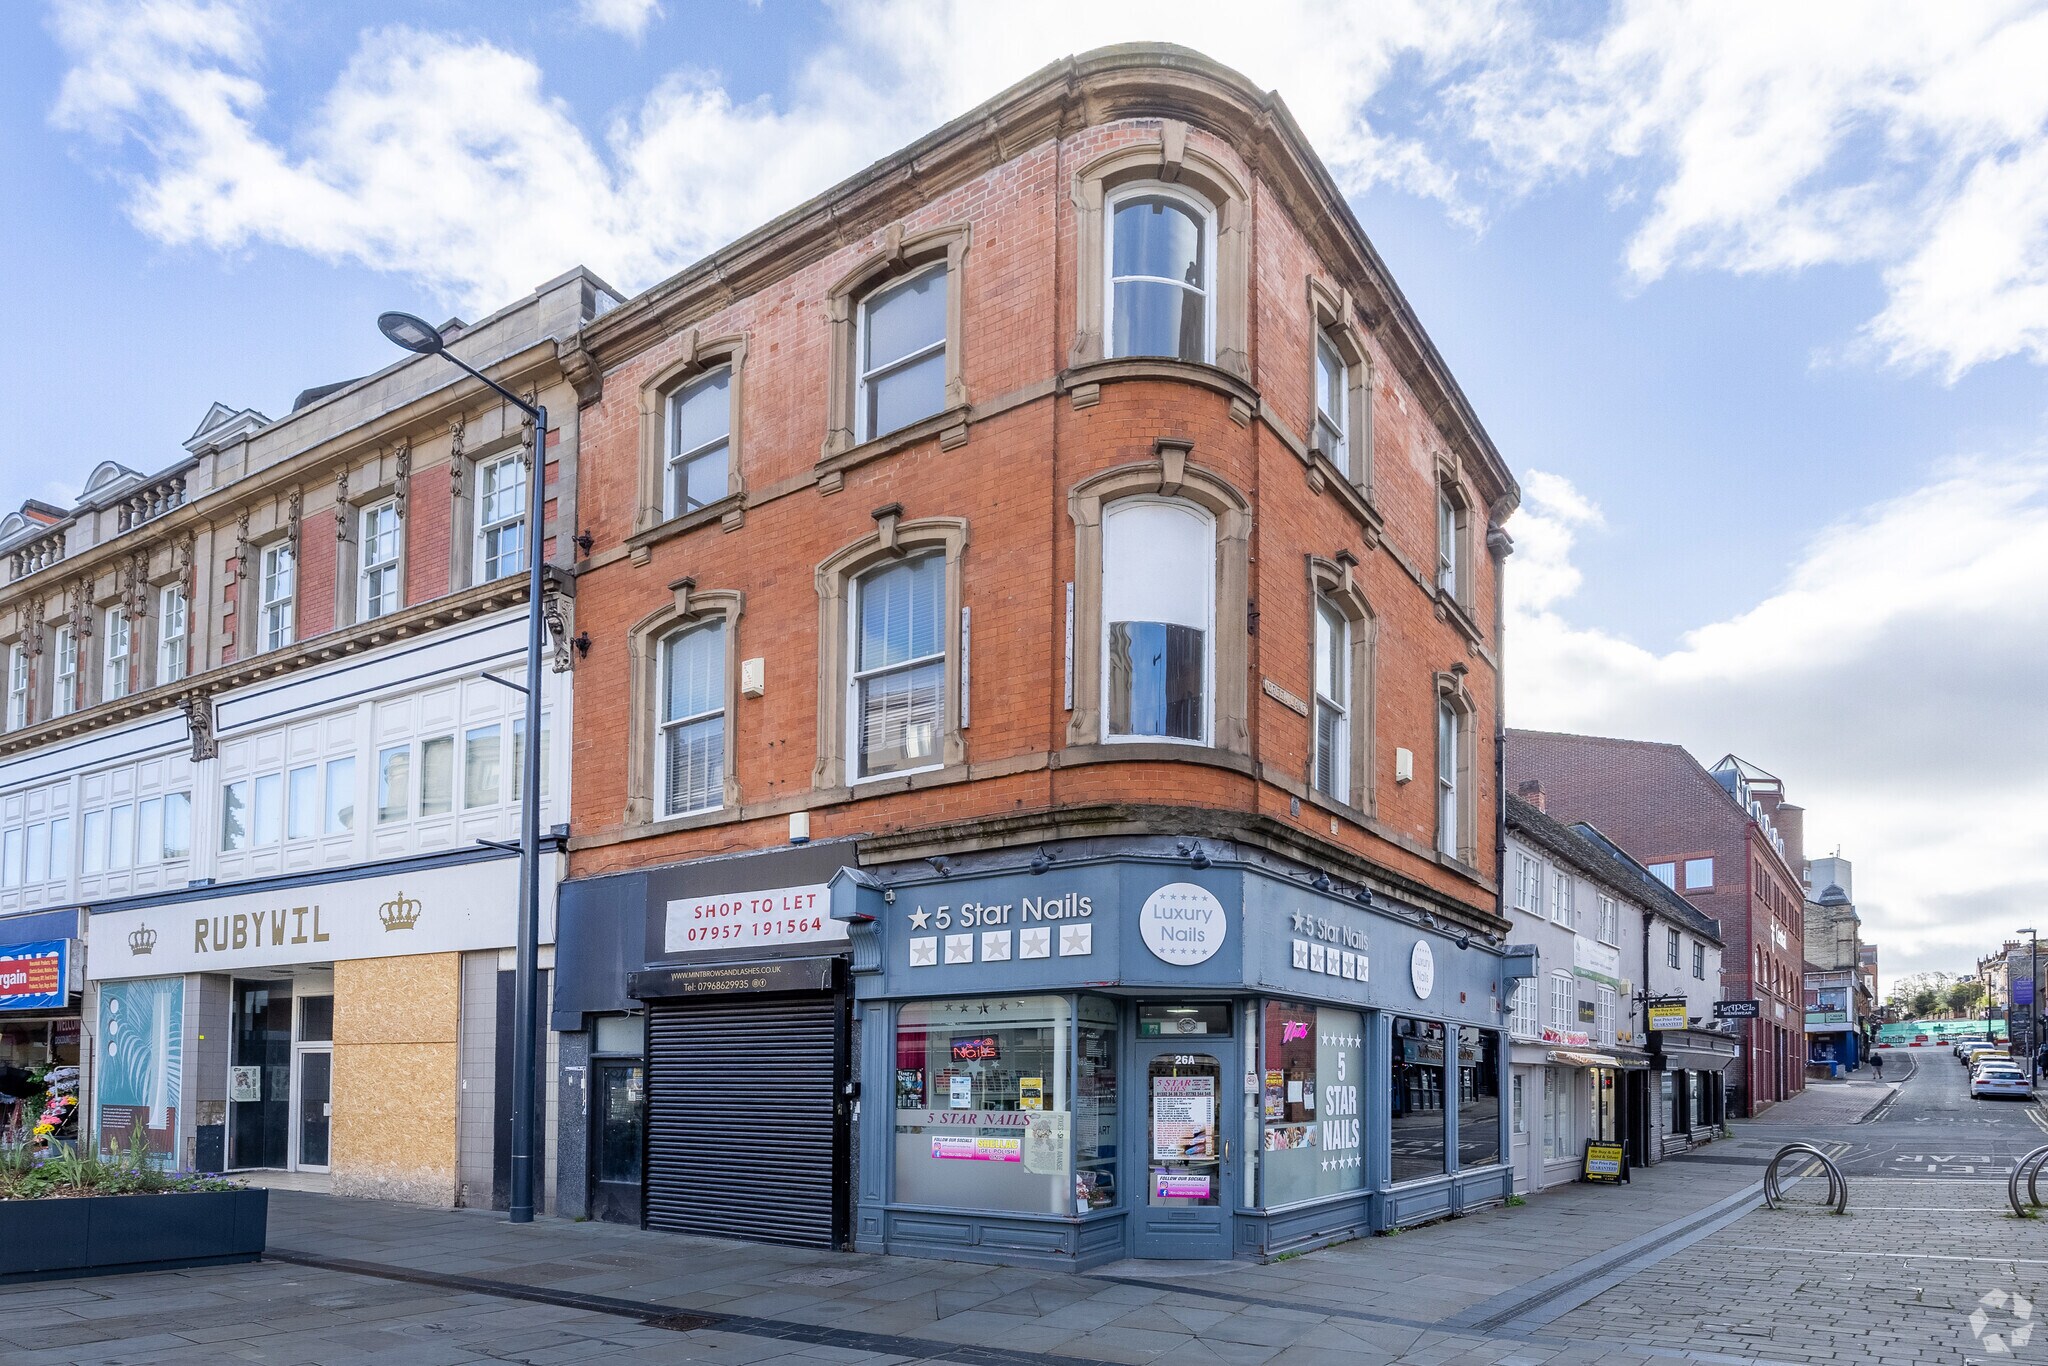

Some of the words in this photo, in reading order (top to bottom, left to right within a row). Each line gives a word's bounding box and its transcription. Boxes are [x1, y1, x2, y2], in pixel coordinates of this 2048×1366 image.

[694, 902, 743, 919] SHOP
[750, 898, 773, 914] TO
[783, 894, 816, 911] LET
[935, 905, 952, 930] 5
[960, 902, 1012, 927] Star
[1022, 892, 1092, 922] Nails
[1154, 904, 1213, 924] Luxury
[194, 905, 329, 953] RUBYWIL
[688, 924, 742, 941] 07957
[752, 917, 822, 936] 191564
[1161, 926, 1205, 942] Nails
[1305, 914, 1314, 936] 5
[1318, 917, 1340, 943] Star
[1342, 925, 1369, 951] Nails
[670, 966, 781, 982] WWW.MINTBROWSANDLASHES.CO.UK
[684, 982, 697, 992] Tel:
[697, 980, 749, 991] 07968629935
[953, 1046, 996, 1059] Nails
[1175, 1055, 1195, 1064] 26A
[1337, 1052, 1346, 1082] 5
[1325, 1085, 1357, 1116] STAR
[927, 1114, 934, 1124] 5
[939, 1113, 977, 1125] STAR
[983, 1114, 1031, 1126] NAILS
[977, 1139, 1018, 1149] SHELLAC
[1322, 1119, 1360, 1151] NAILS
